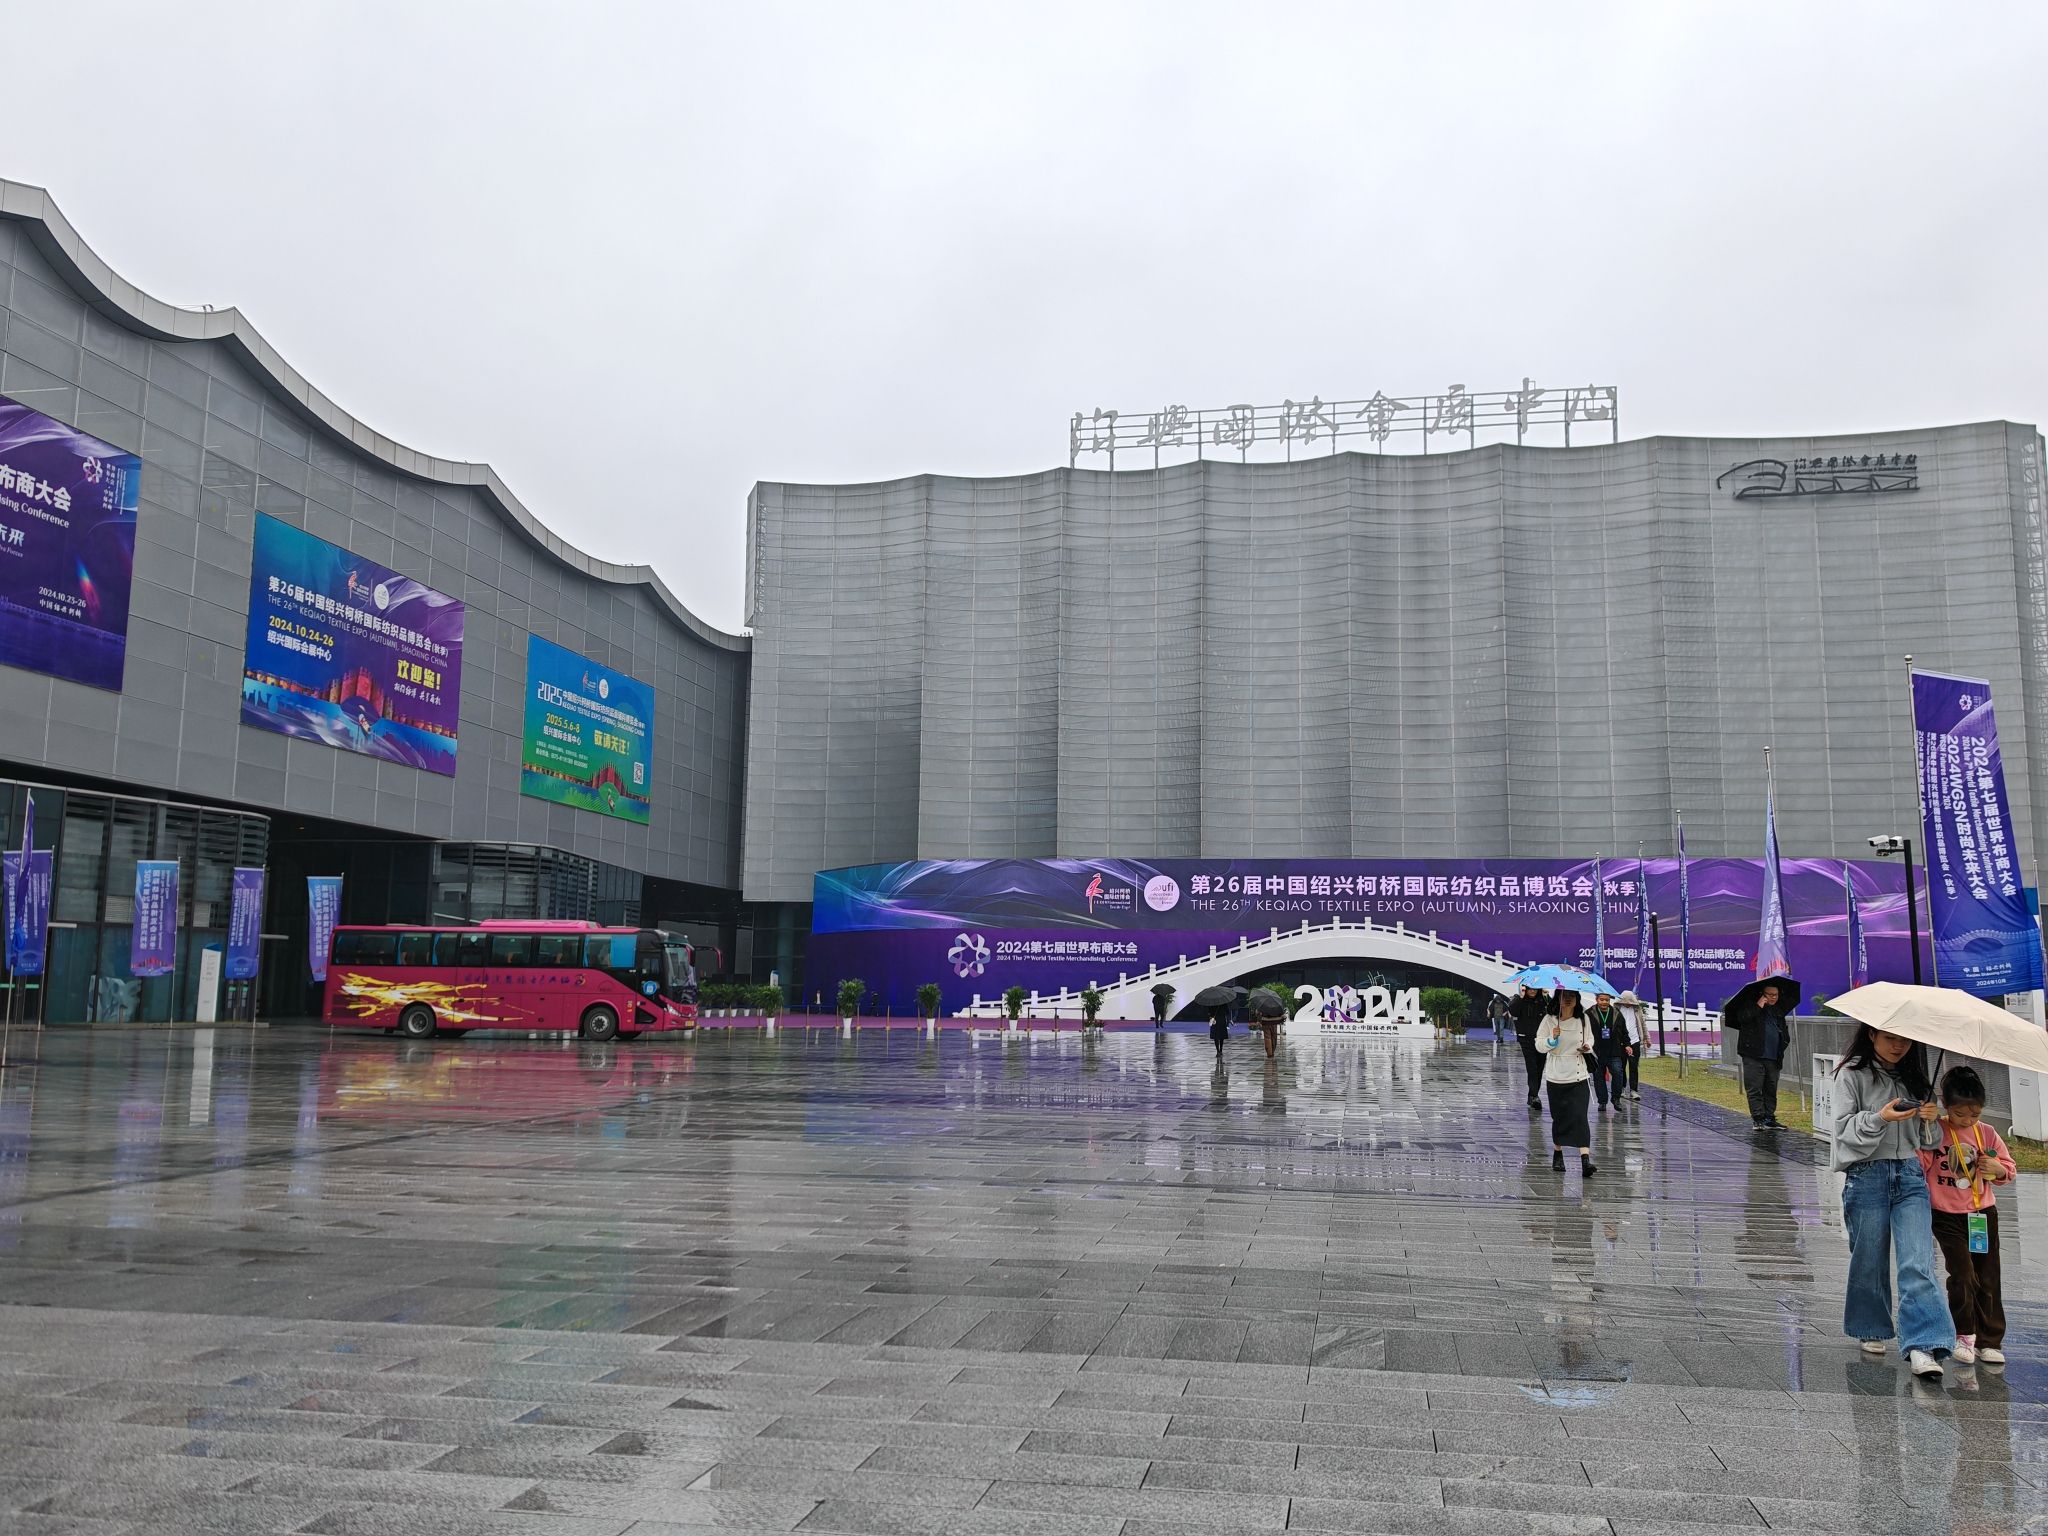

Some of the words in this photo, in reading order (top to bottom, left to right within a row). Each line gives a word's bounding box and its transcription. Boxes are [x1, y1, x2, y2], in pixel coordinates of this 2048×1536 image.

[21, 502, 70, 528] Conference
[39, 587, 87, 608] 2024.10.23-26
[268, 594, 281, 607] THE
[300, 605, 326, 623] KEQIAO
[328, 616, 351, 632] TEXTILE
[352, 626, 368, 638] EXPO
[430, 655, 448, 668] CHINA
[269, 615, 334, 647] 2024.10.24-26
[267, 629, 332, 662] 绍兴国际会展中心
[546, 712, 580, 734] 2025.5.6-8
[1962, 736, 1971, 750] 2024
[1941, 776, 1949, 795] China
[1966, 770, 1976, 788] World
[1943, 795, 1952, 810] 2024
[1947, 735, 1988, 899] 2024WGSN时尚未来大会
[1971, 736, 2017, 897] 2024第七届世界布商大会
[1162, 882, 1174, 892] ufi
[1191, 875, 1640, 897] 第26届中国绍兴柯桥国际纺织品博览会秋季)
[1191, 900, 1215, 911] THE
[1222, 899, 1251, 911] 26TH
[1256, 900, 1312, 912] KEQIAO
[1319, 900, 1371, 912] TEXTILE
[1377, 900, 1415, 912] EXPO
[1421, 900, 1502, 915] (AUTUMN),
[1508, 901, 1590, 913] SHAOXING
[996, 941, 1138, 955] 2024第七届世界布商大会
[1066, 955, 1106, 963] Merchandising
[1604, 961, 1622, 970] eqiao
[1689, 961, 1724, 971] Shaoxing,
[1725, 961, 1745, 969] China
